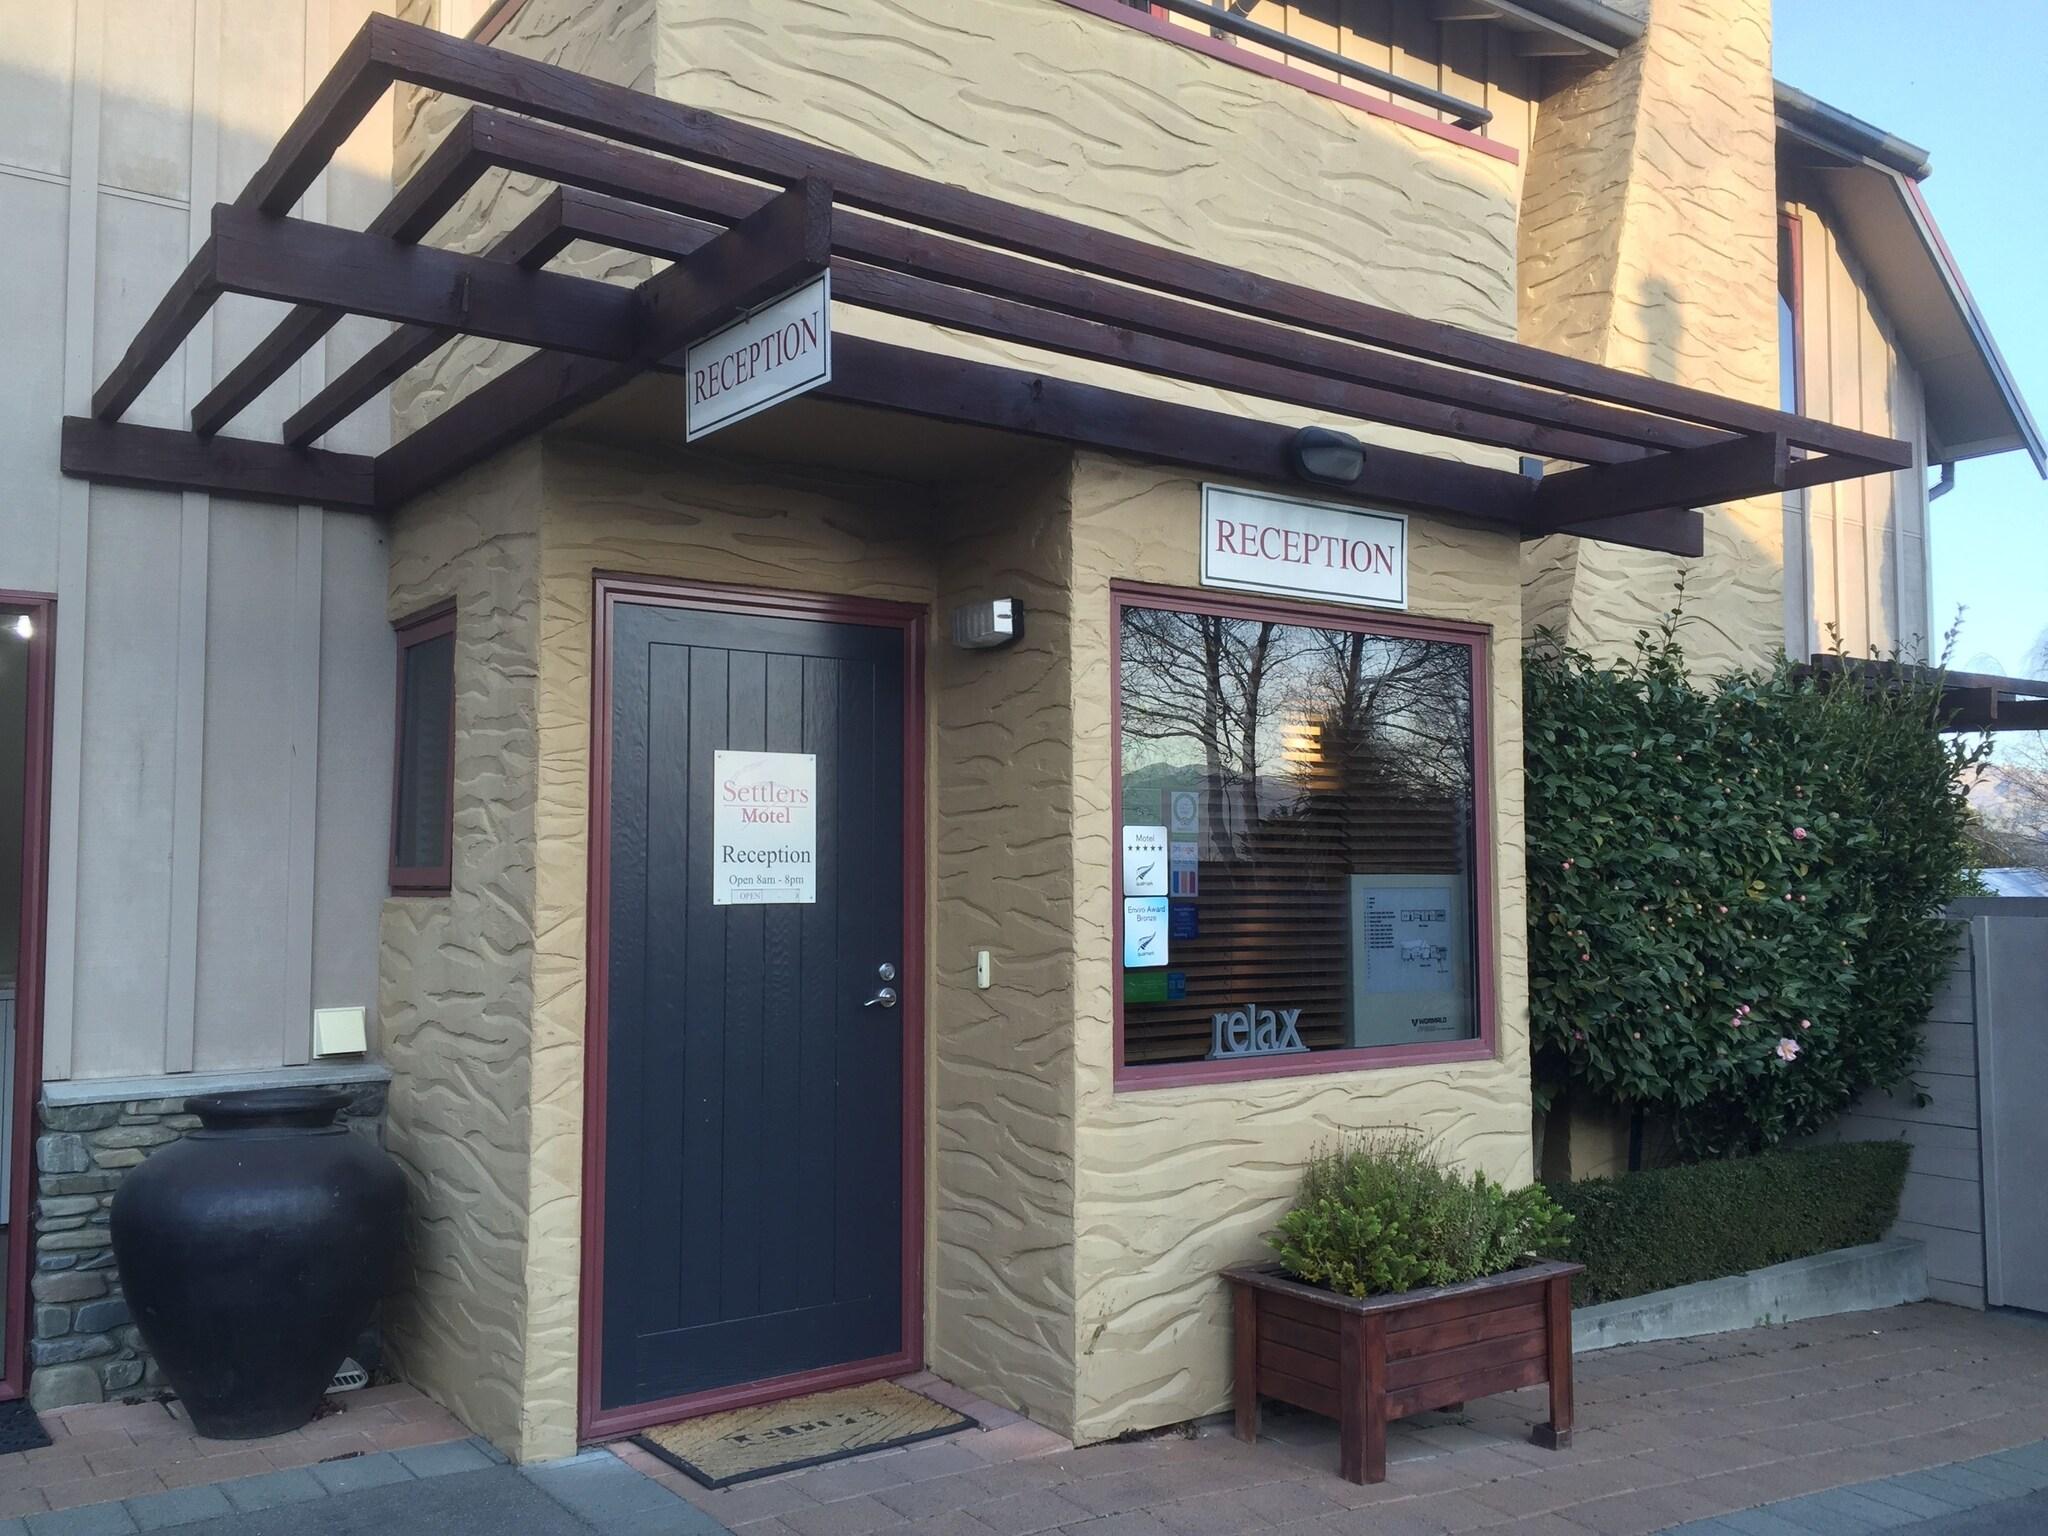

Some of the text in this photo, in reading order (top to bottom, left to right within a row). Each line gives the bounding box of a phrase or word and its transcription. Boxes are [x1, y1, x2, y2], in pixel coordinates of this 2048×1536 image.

[694, 311, 819, 405] RECEPTION
[1216, 519, 1395, 576] RECEPTION
[723, 779, 809, 804] Settlers
[742, 807, 791, 824] Motel
[1135, 834, 1155, 842] Motel
[722, 845, 811, 868] Reception
[729, 874, 754, 887] Open
[756, 874, 776, 885] 8am
[784, 874, 804, 887] 8pm
[1147, 905, 1166, 913] Award
[1207, 1003, 1308, 1059] relax
